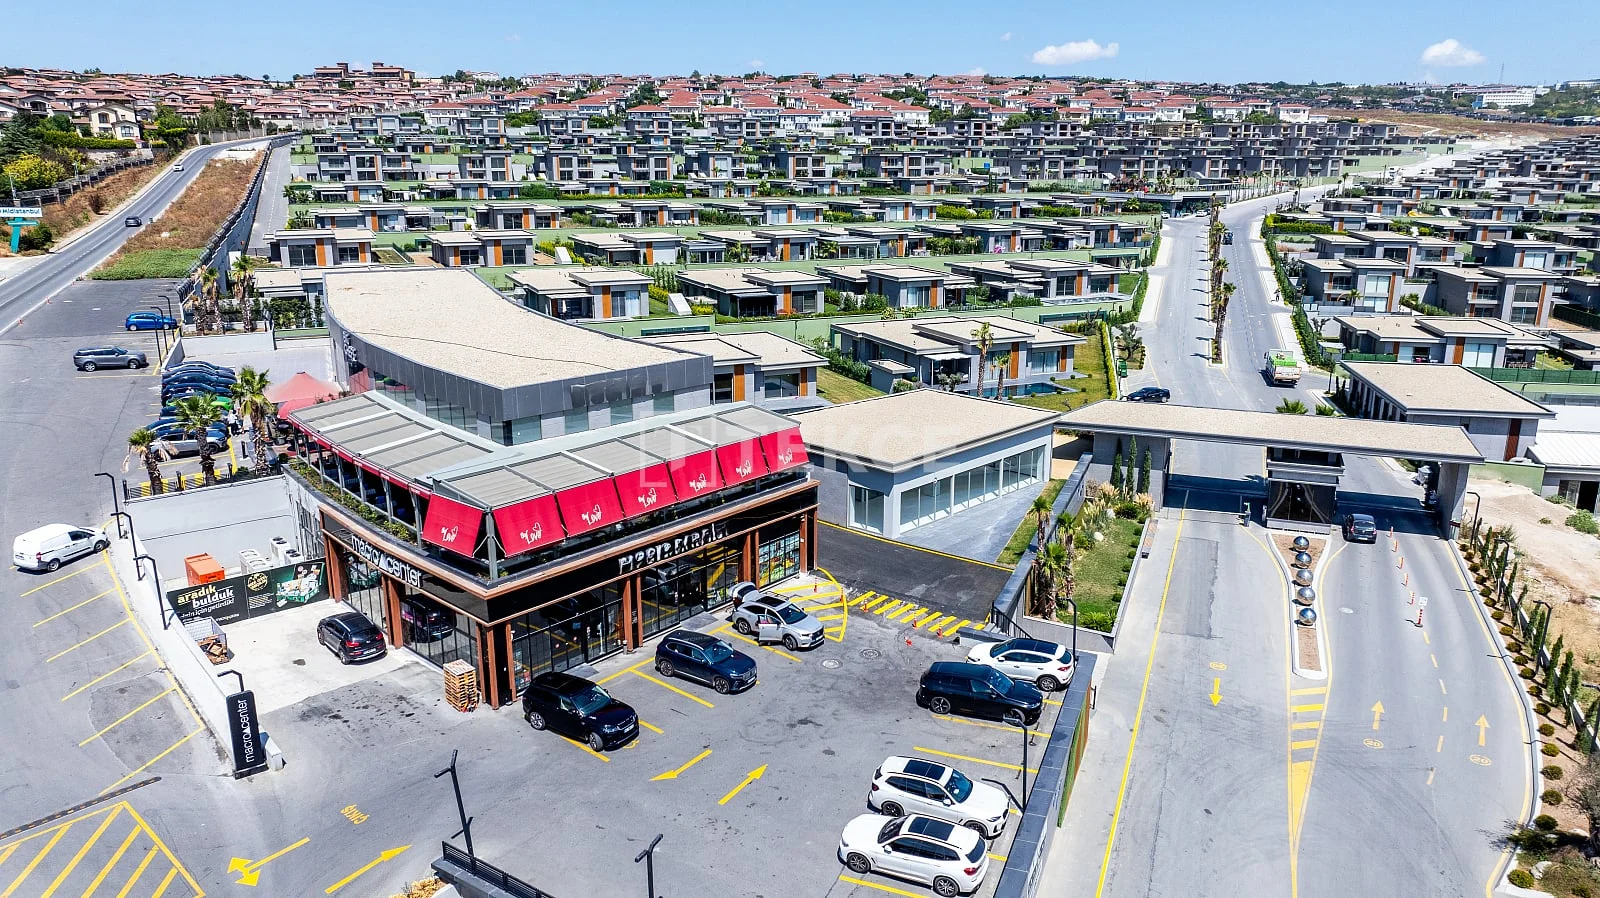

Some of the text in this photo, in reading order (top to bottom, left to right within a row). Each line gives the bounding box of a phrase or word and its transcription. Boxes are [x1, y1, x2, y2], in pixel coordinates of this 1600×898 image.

[177, 584, 216, 604] aradık
[192, 588, 233, 608] bulduk
[237, 699, 250, 729] center
